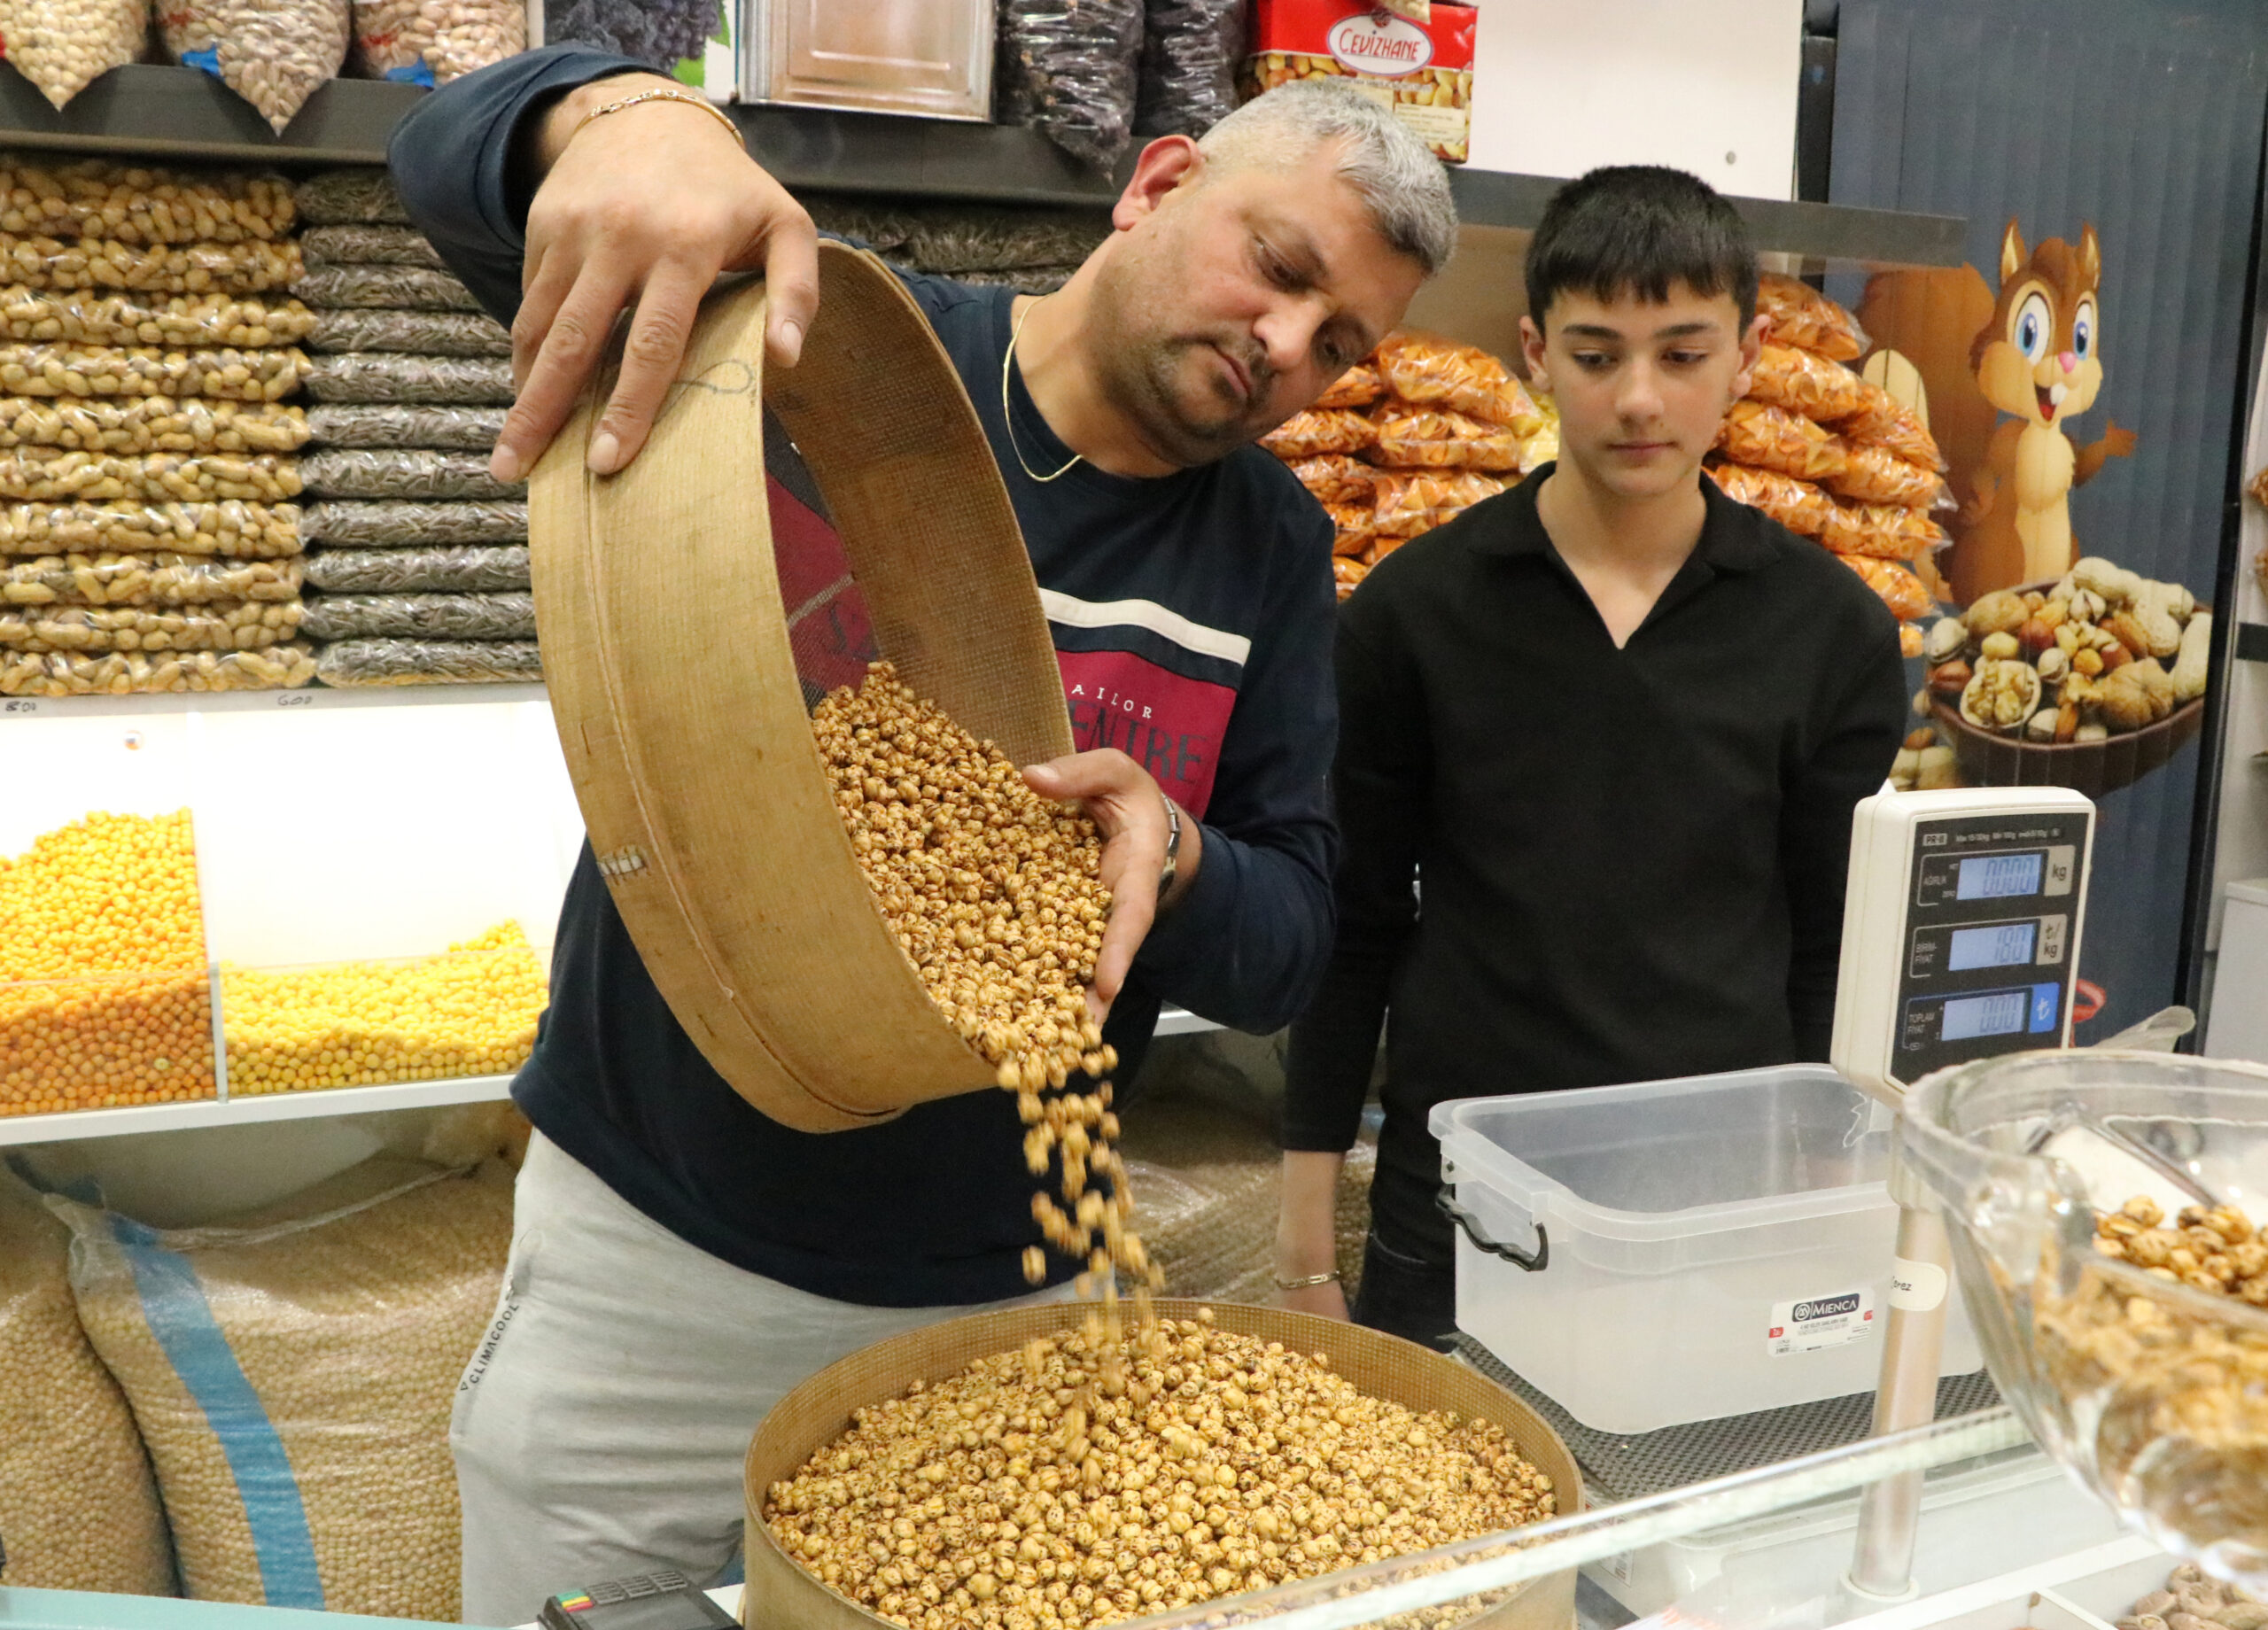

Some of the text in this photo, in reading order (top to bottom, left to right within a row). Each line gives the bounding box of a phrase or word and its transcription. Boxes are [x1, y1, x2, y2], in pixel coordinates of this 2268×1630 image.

[1071, 684, 1153, 718] AILOR
[1068, 699, 1208, 784] ENTRE
[2052, 864, 2067, 881] kg
[2044, 943, 2058, 959] kg
[469, 1305, 519, 1384] CLIMACOOL
